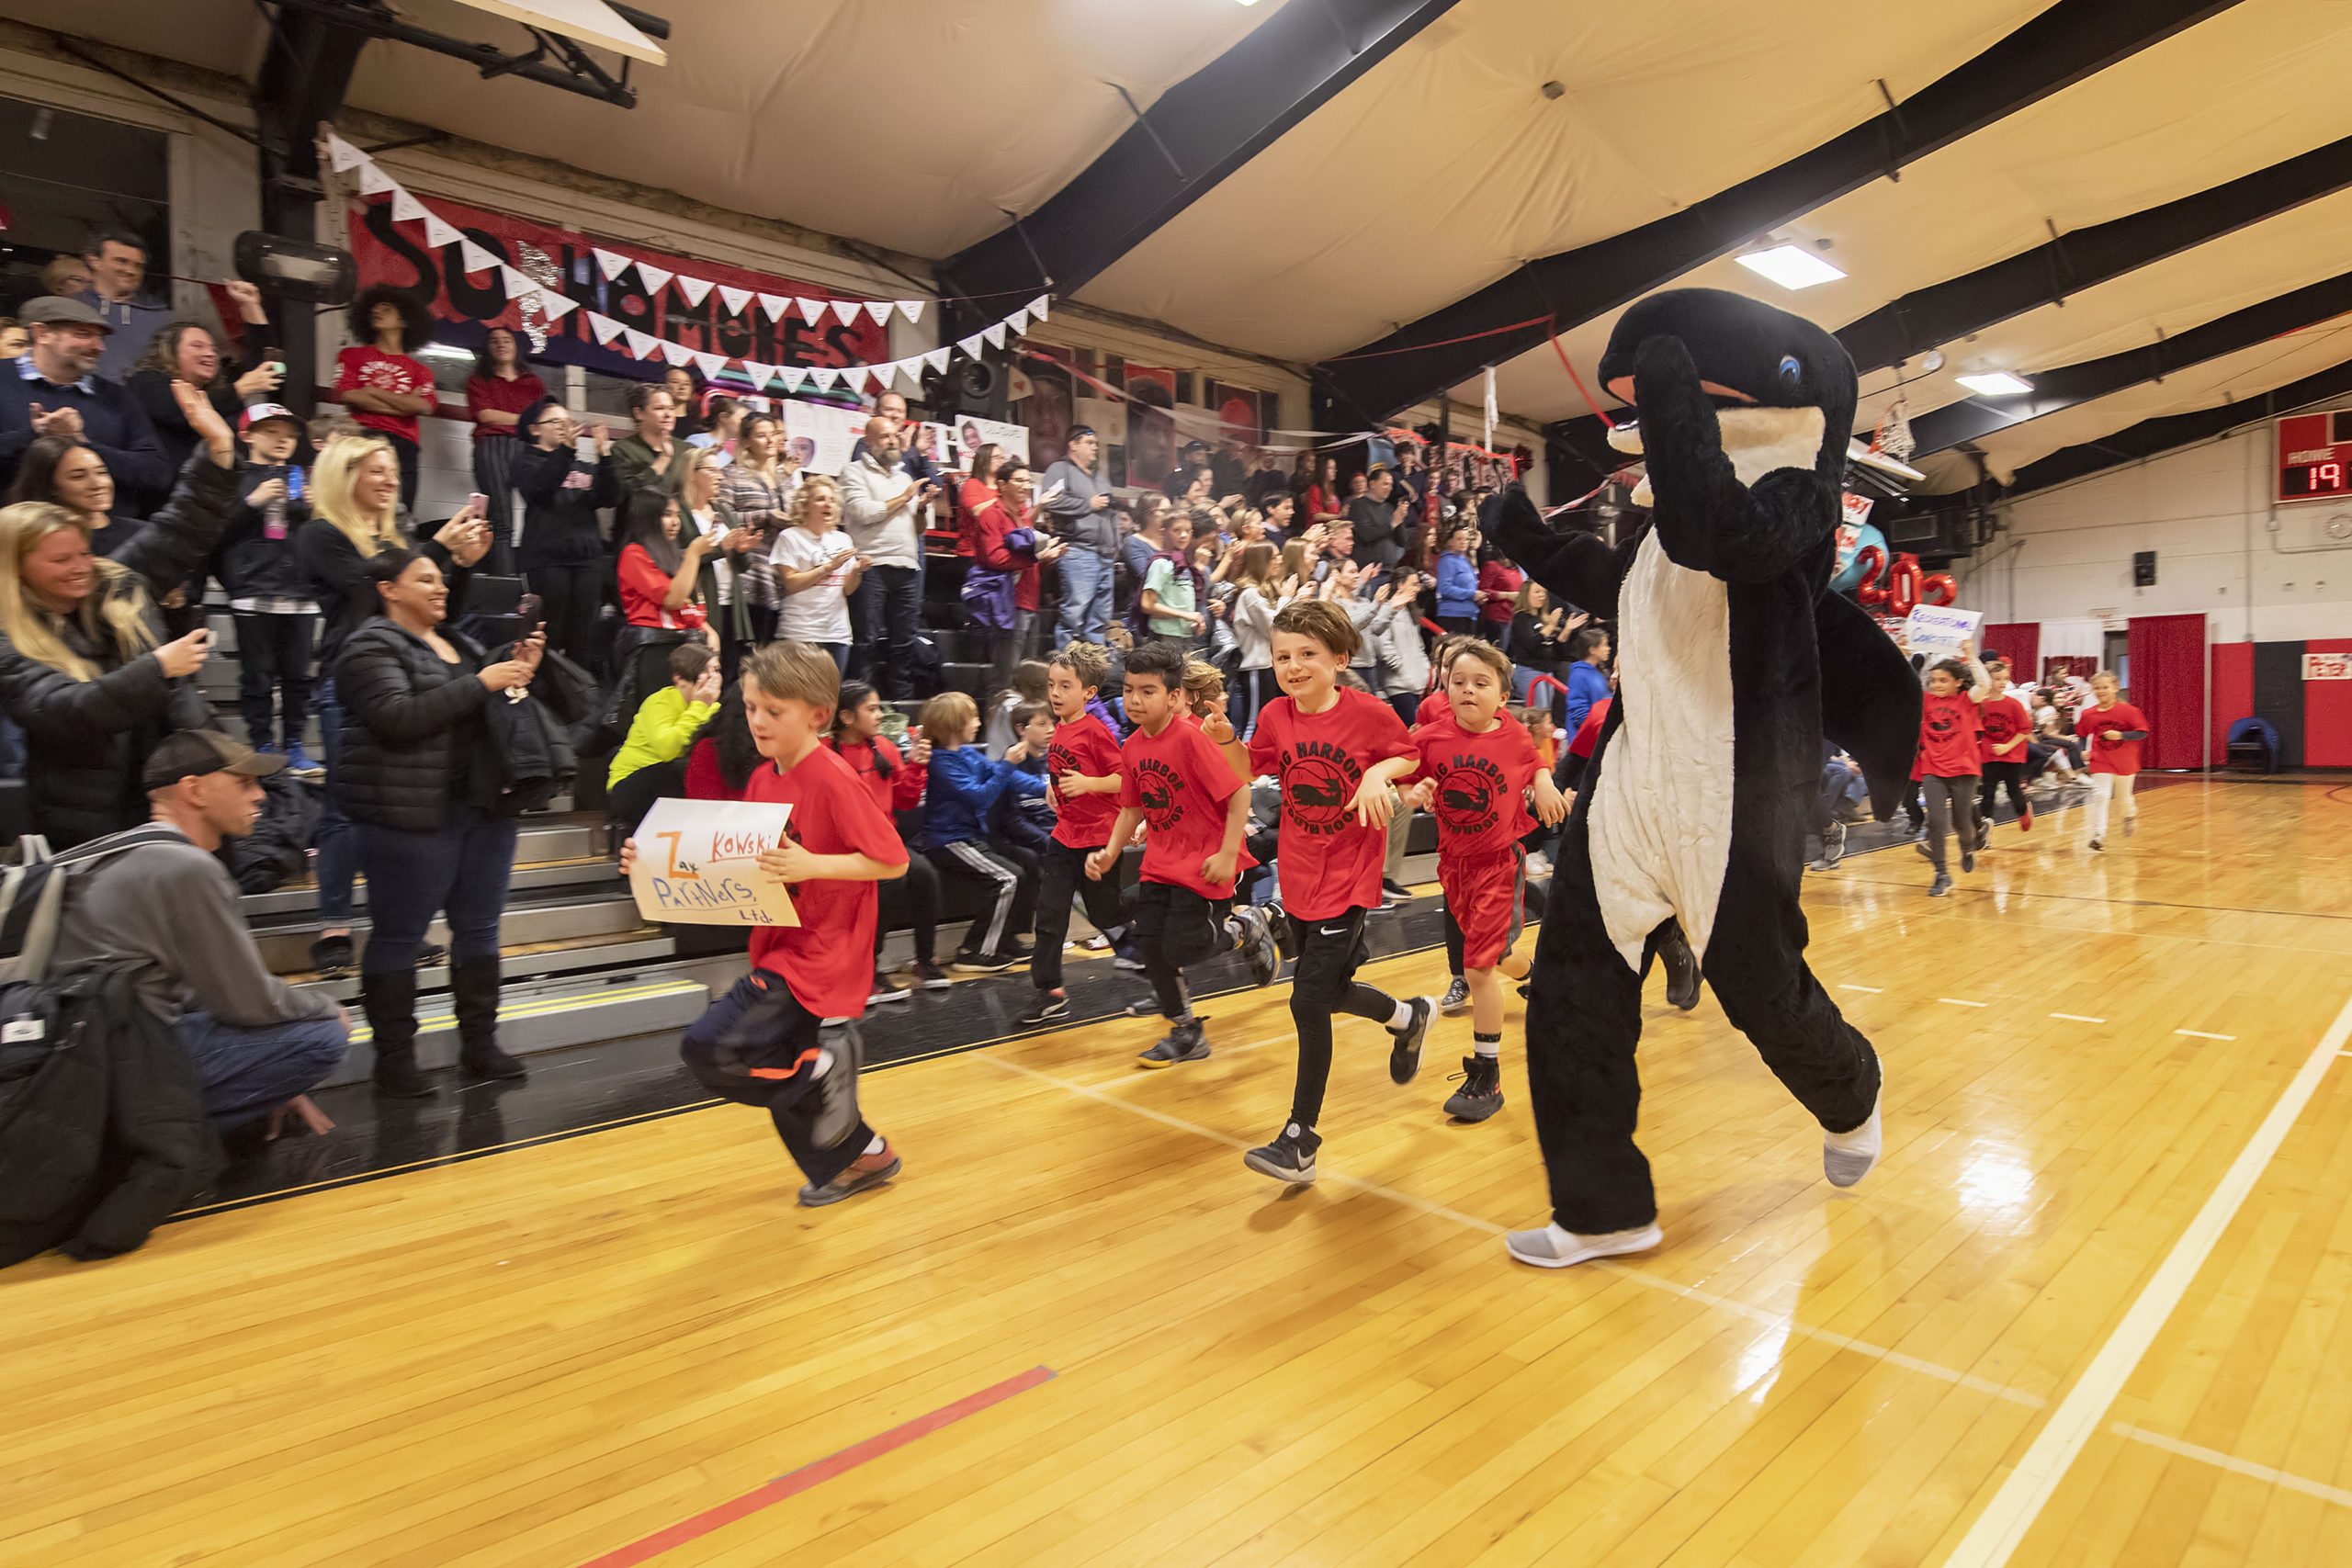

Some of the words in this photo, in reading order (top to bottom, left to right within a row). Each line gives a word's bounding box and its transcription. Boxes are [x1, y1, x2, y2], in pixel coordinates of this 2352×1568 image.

[2287, 447, 2335, 465] HOME
[2309, 463, 2340, 491] 19
[1139, 758, 1185, 792] HARBOR
[1295, 740, 1362, 784] HARBOR
[1453, 754, 1508, 796] HARBOR
[1323, 807, 1360, 835] HOO
